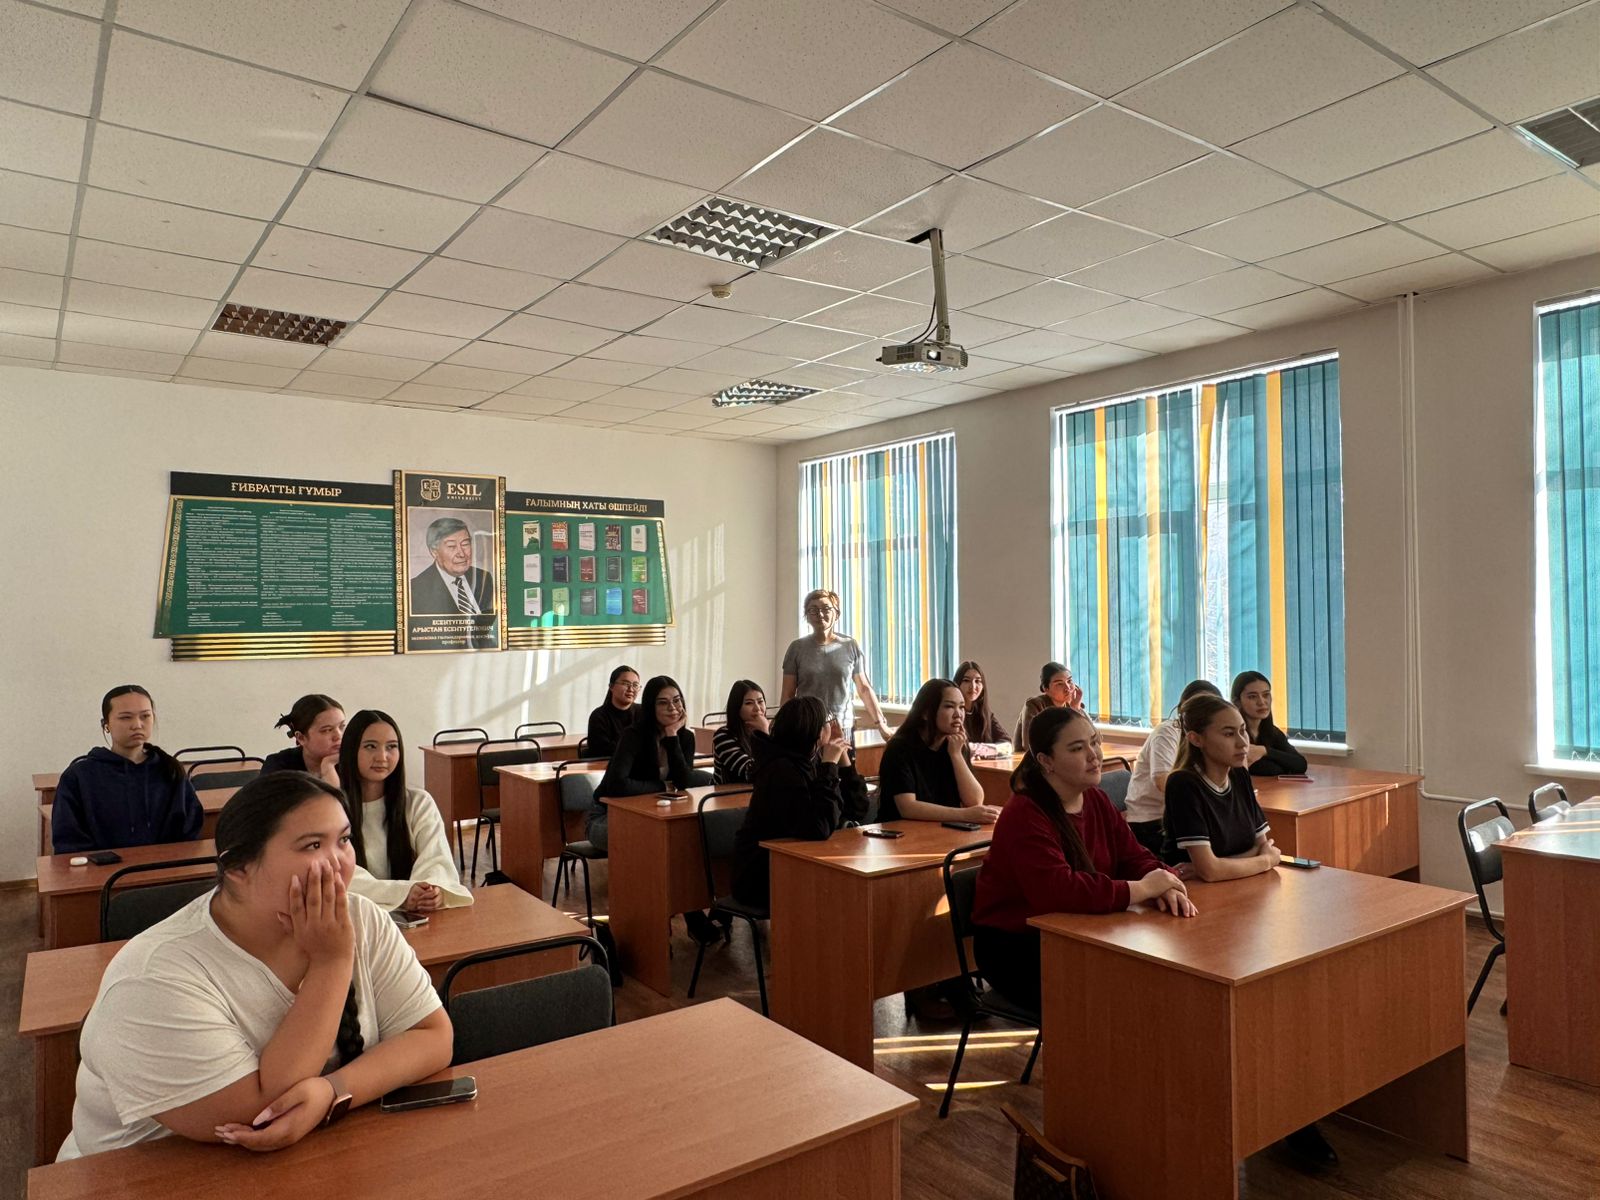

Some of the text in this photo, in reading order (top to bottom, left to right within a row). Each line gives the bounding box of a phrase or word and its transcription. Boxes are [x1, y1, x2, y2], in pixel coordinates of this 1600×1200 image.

[231, 482, 296, 494] ҒИБРАТТЫ
[447, 483, 482, 496] ESIL
[525, 498, 648, 513] ҒАЛЫМНЫҢ ХАТЫ ӨШПЕЙДІ
